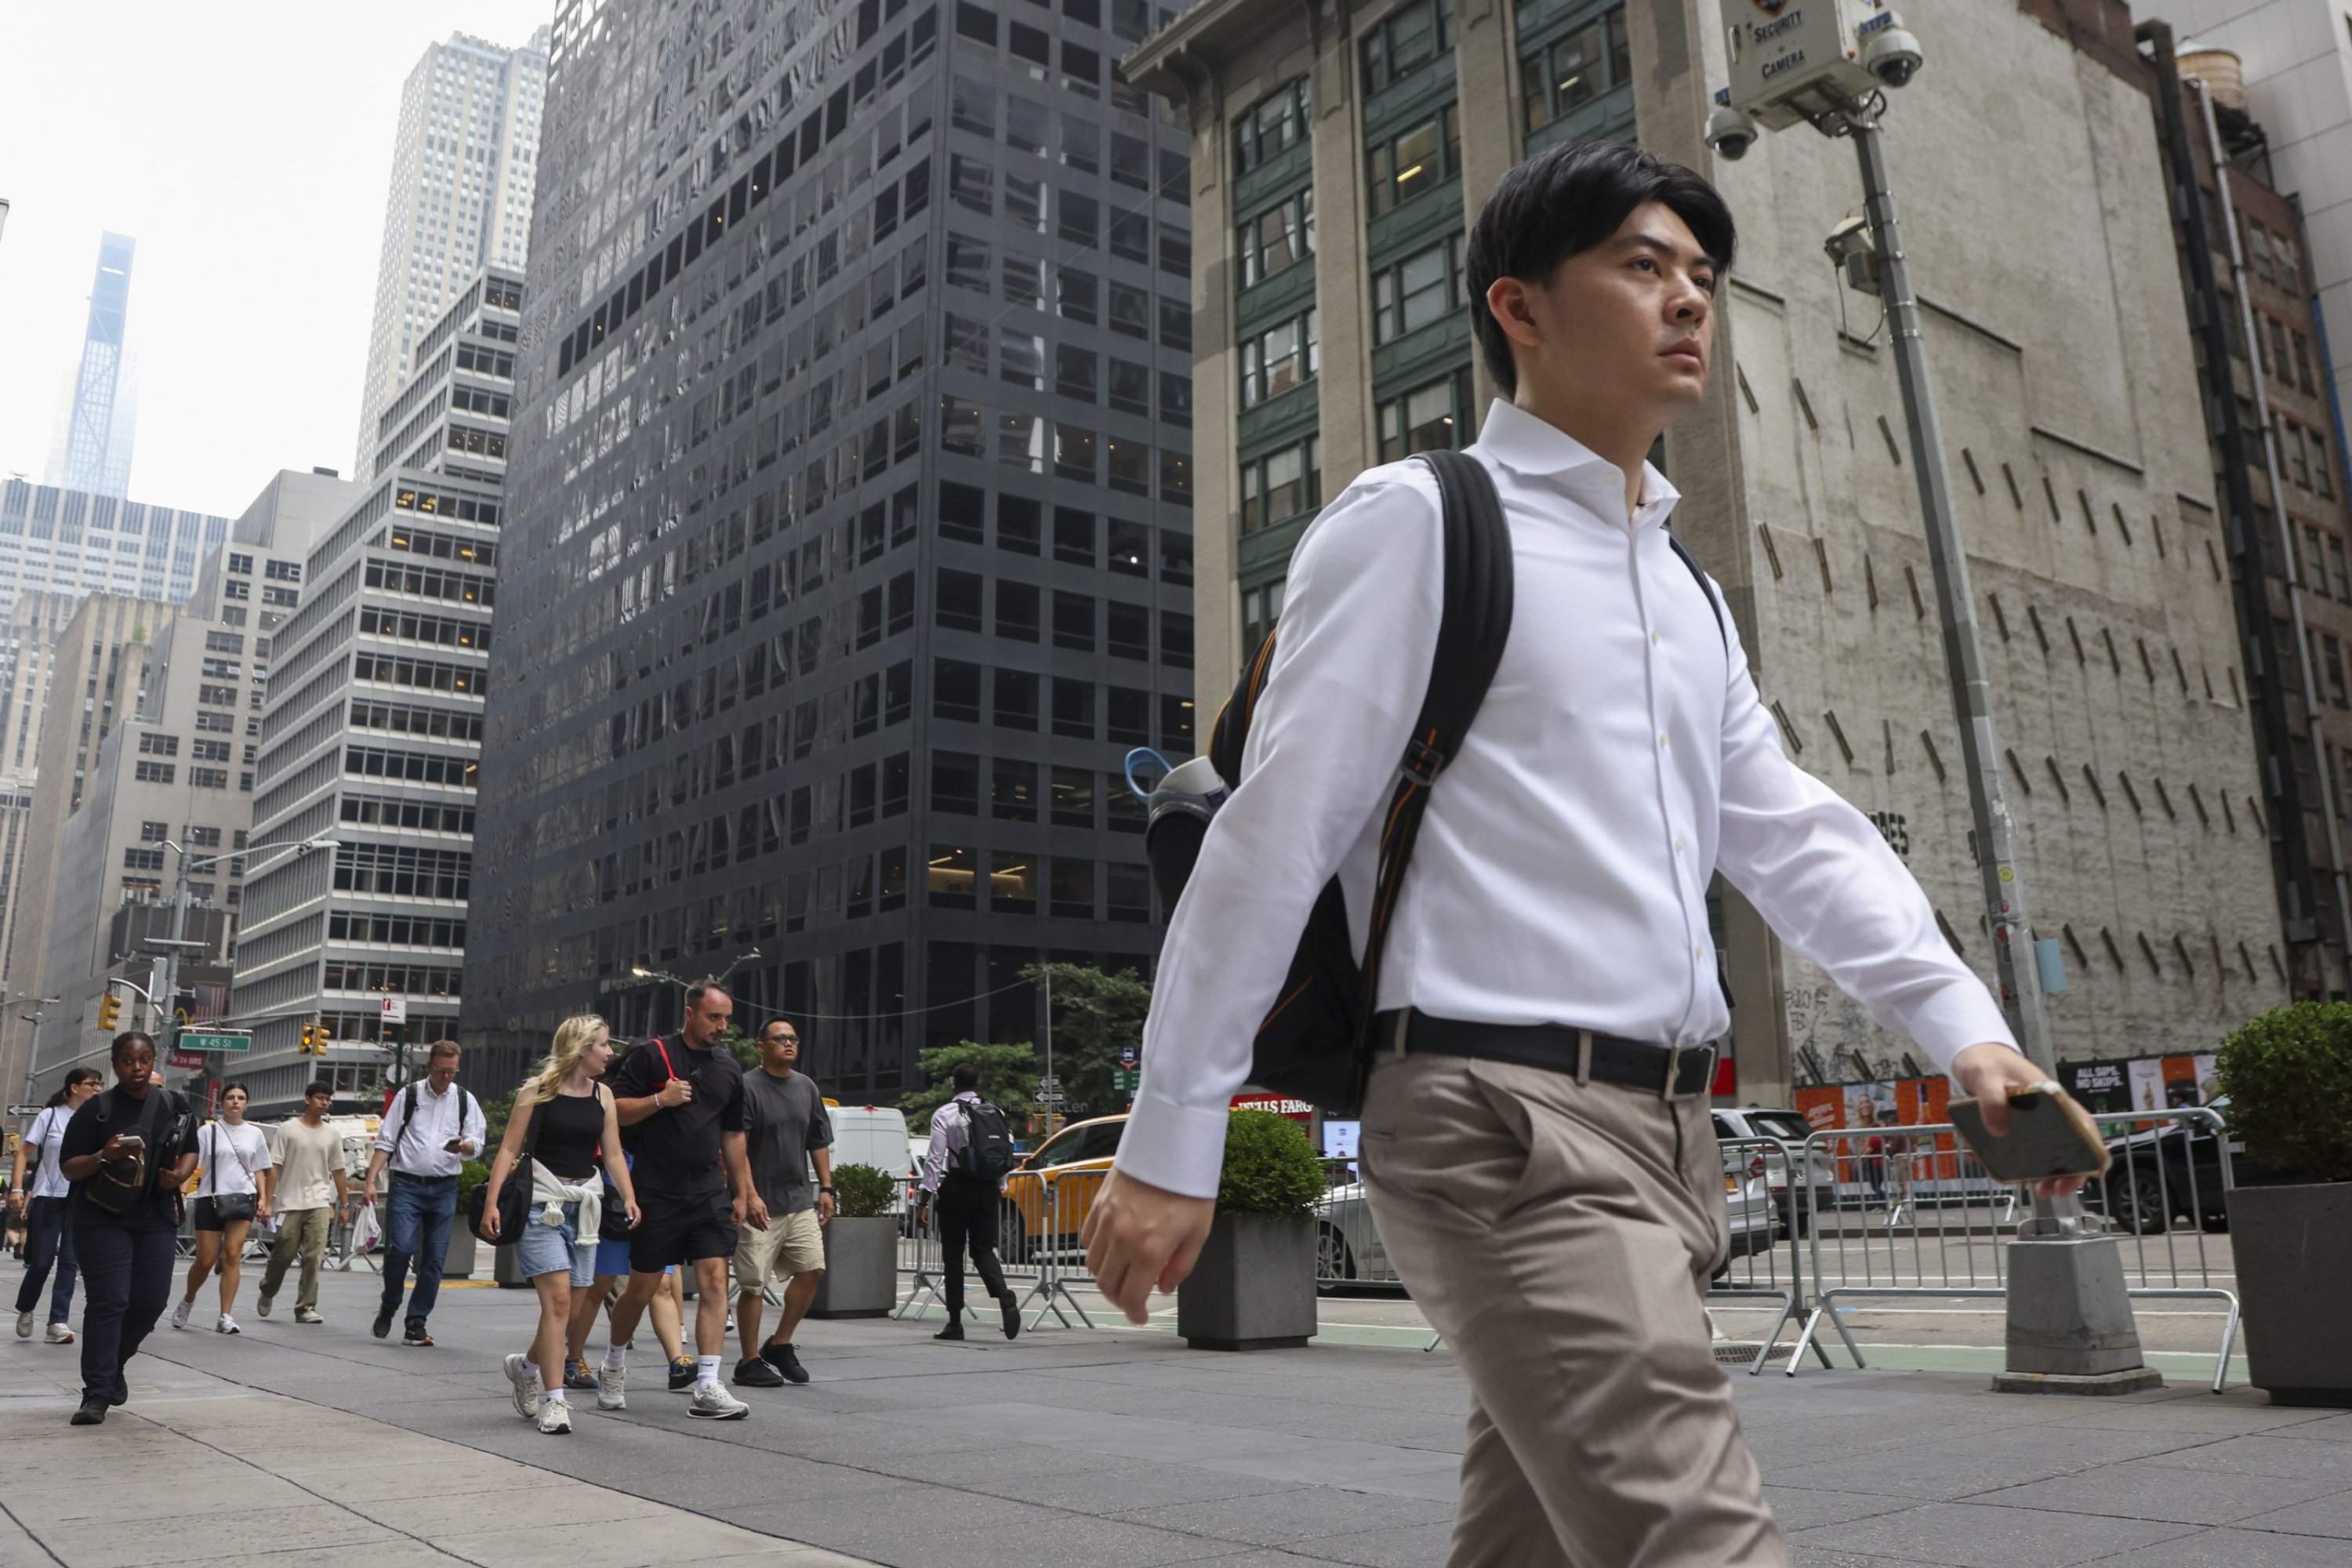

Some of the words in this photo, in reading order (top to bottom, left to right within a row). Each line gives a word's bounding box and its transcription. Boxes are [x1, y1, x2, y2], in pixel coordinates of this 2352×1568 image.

[1755, 9, 1802, 42] SECURITY
[1762, 49, 1806, 79] CAMERA
[199, 1037, 208, 1047] W
[209, 1038, 220, 1047] 45
[223, 1039, 233, 1048] St
[2077, 1067, 2095, 1078] ALL
[2076, 1078, 2091, 1089] NO
